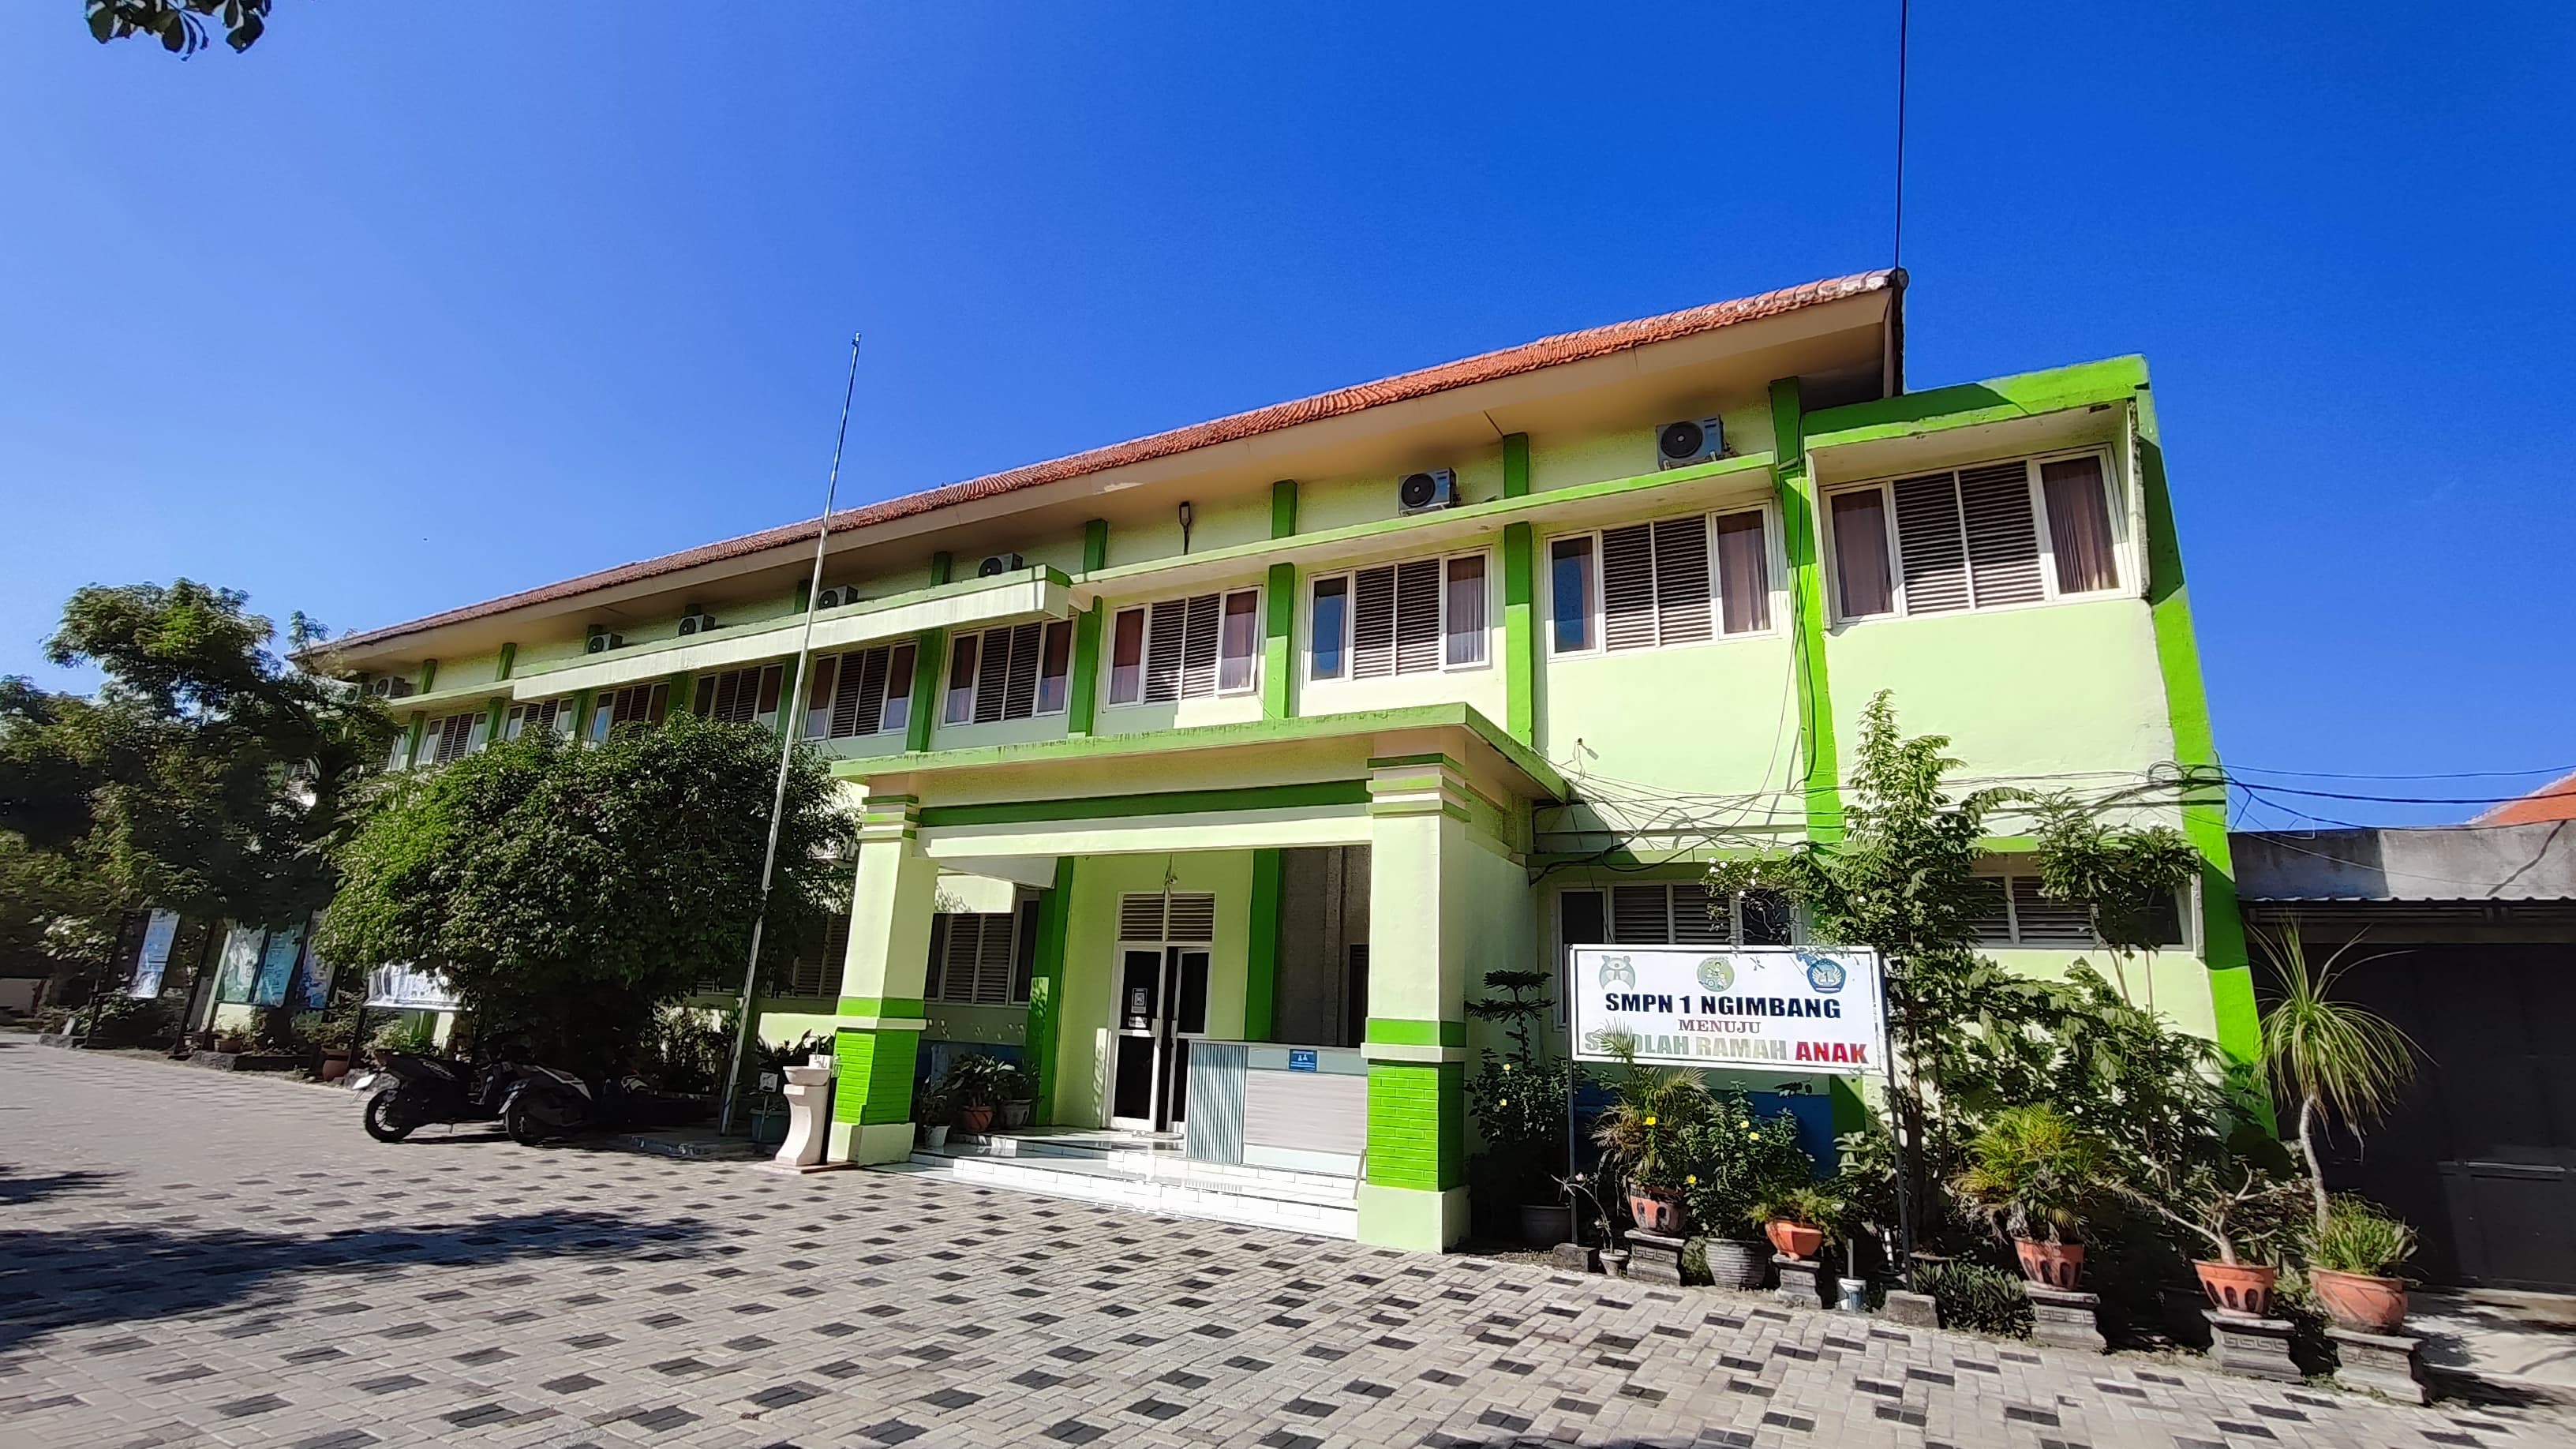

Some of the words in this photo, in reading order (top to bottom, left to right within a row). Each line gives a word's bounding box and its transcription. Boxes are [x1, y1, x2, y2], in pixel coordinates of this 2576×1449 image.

[1605, 993, 1673, 1013] SMPN
[1679, 995, 1690, 1013] 1
[1701, 995, 1841, 1018] NGIMBANG
[1678, 1019, 1762, 1034] MENUJU
[1695, 1036, 1788, 1060] RAMAH
[1795, 1041, 1869, 1064] ANAK
